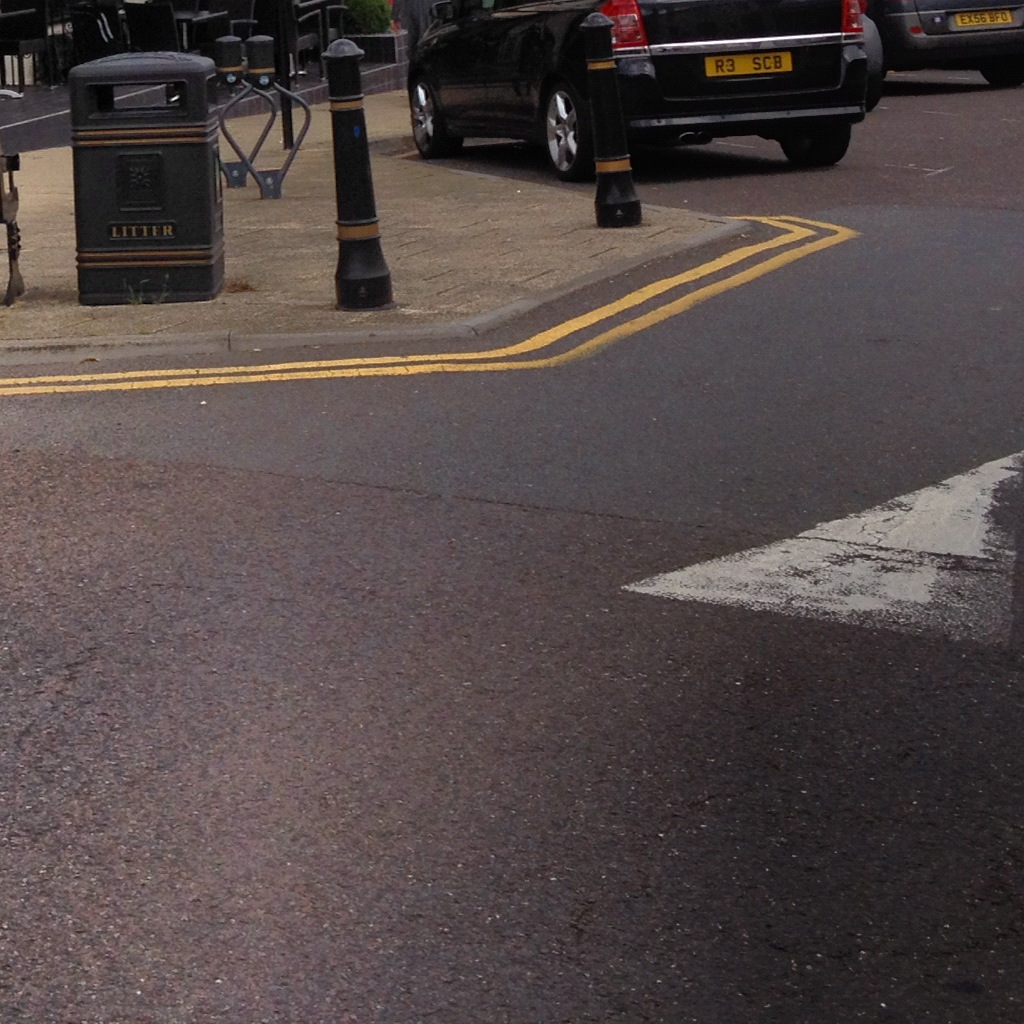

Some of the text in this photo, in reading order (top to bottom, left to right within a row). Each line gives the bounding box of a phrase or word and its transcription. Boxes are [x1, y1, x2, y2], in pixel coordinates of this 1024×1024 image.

[715, 55, 783, 73] R3 SCB
[111, 225, 174, 239] LITTER
